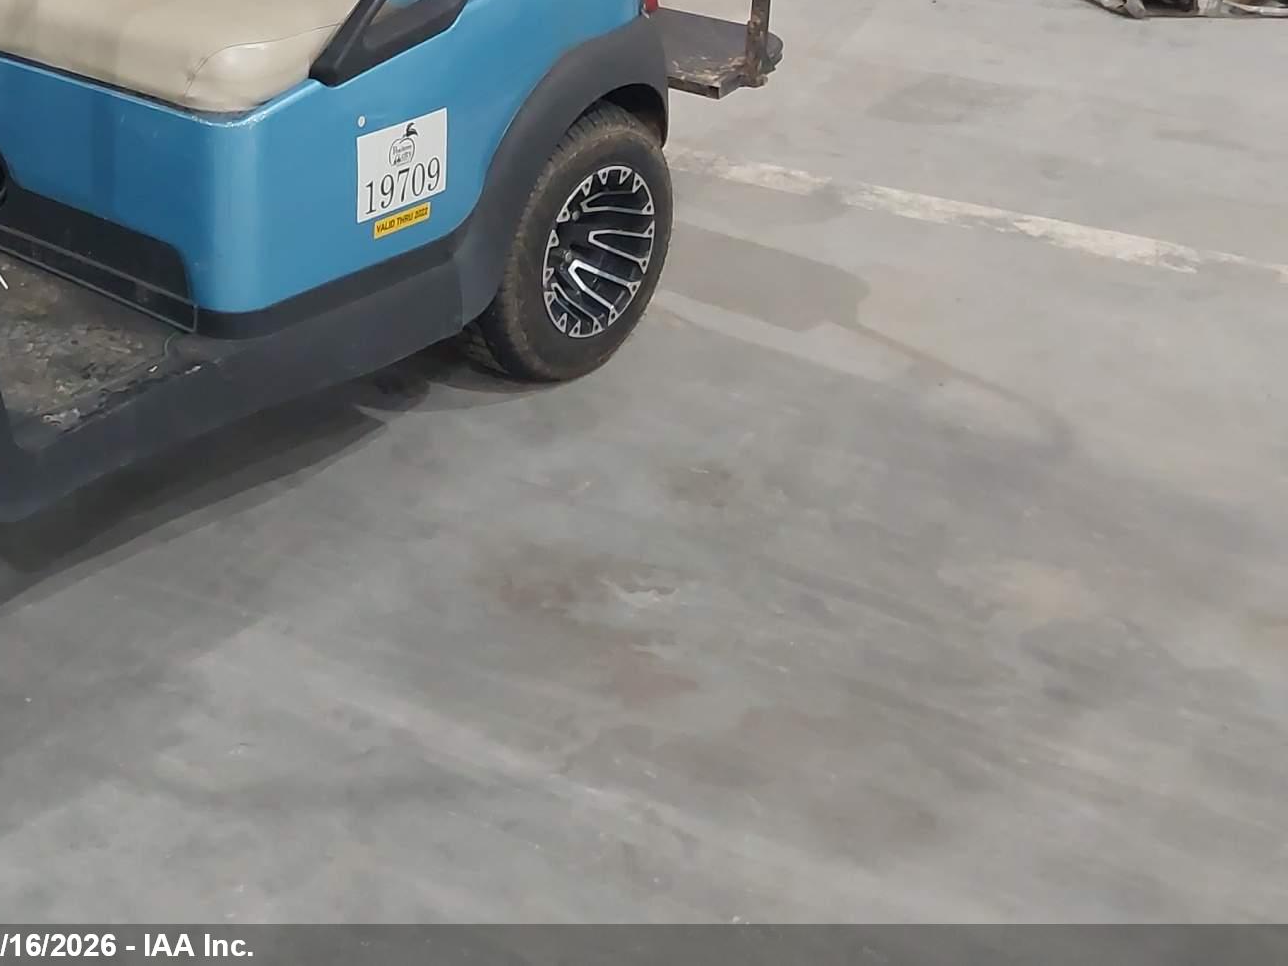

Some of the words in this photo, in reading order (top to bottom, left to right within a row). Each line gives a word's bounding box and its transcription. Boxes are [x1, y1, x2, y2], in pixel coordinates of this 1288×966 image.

[365, 157, 440, 215] 19709
[376, 219, 396, 233] VALID
[396, 213, 414, 226] THRU
